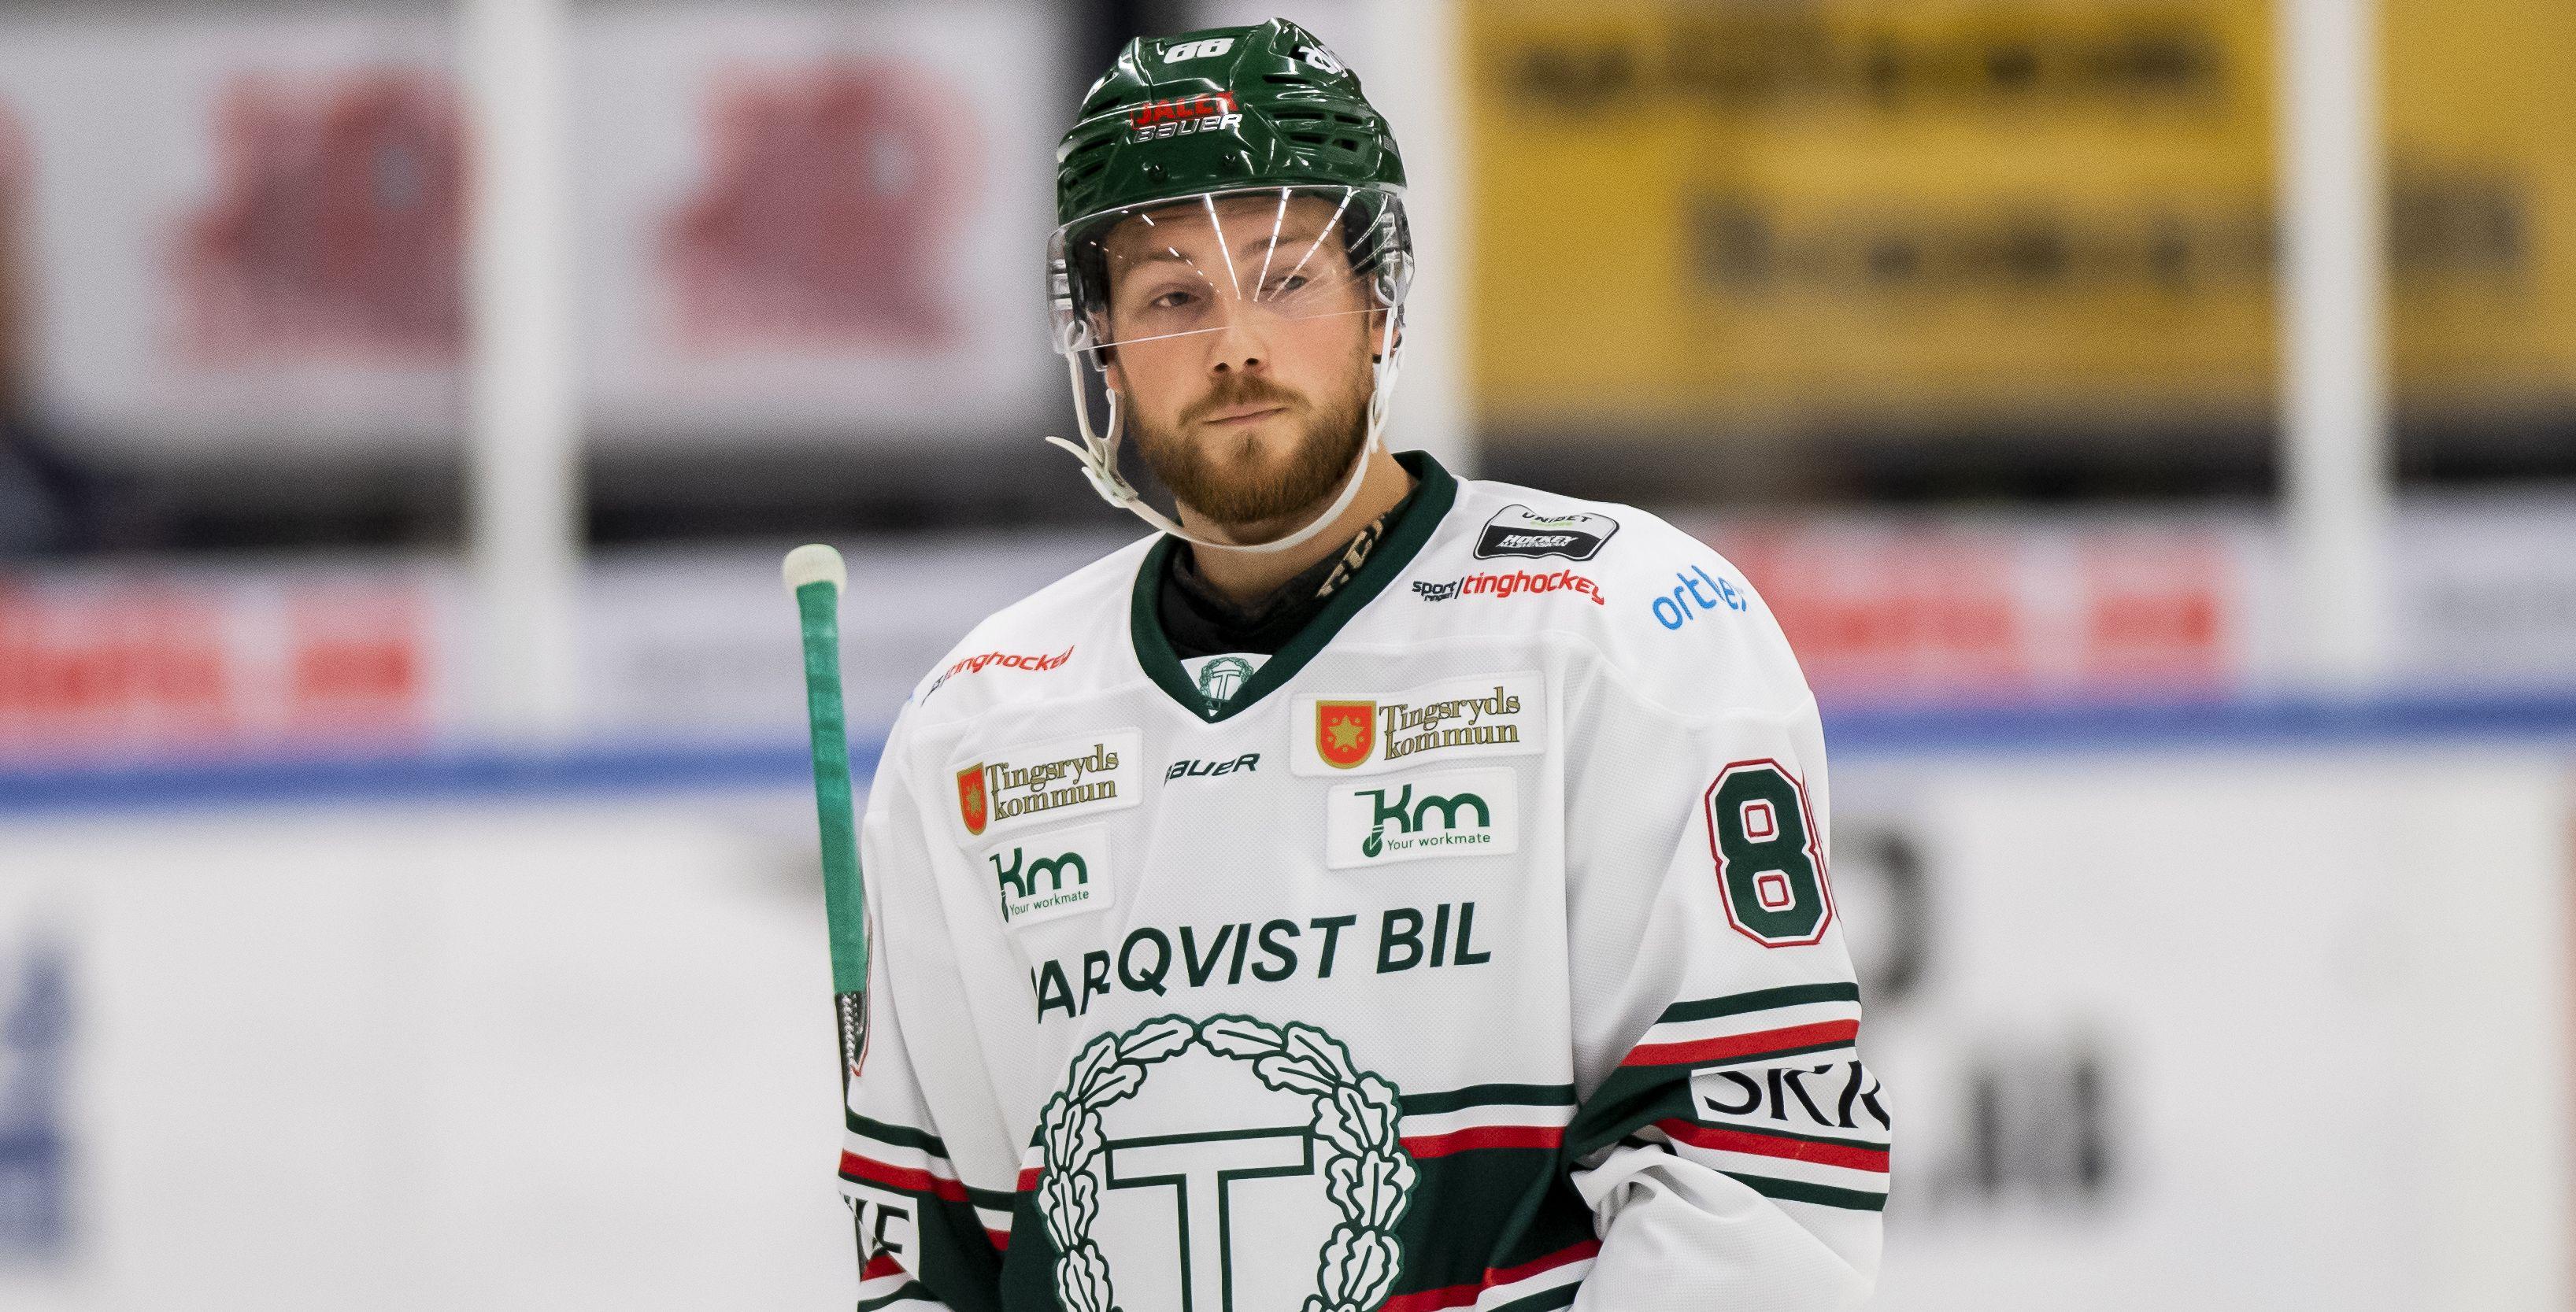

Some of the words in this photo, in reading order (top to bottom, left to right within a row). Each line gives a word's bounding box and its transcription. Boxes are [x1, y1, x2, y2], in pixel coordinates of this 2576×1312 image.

[1379, 686, 1521, 732] Tingsryds
[1384, 720, 1520, 760] kommun
[985, 743, 1120, 793] Tingsryds
[1164, 753, 1260, 787] AUER
[990, 779, 1118, 821] kommun
[1387, 838, 1415, 851] Your
[1419, 832, 1491, 846] workmate
[1704, 758, 1841, 948] 8
[1009, 903, 1030, 916] Your
[1034, 890, 1090, 910] workmate
[1375, 901, 1492, 974] BIL
